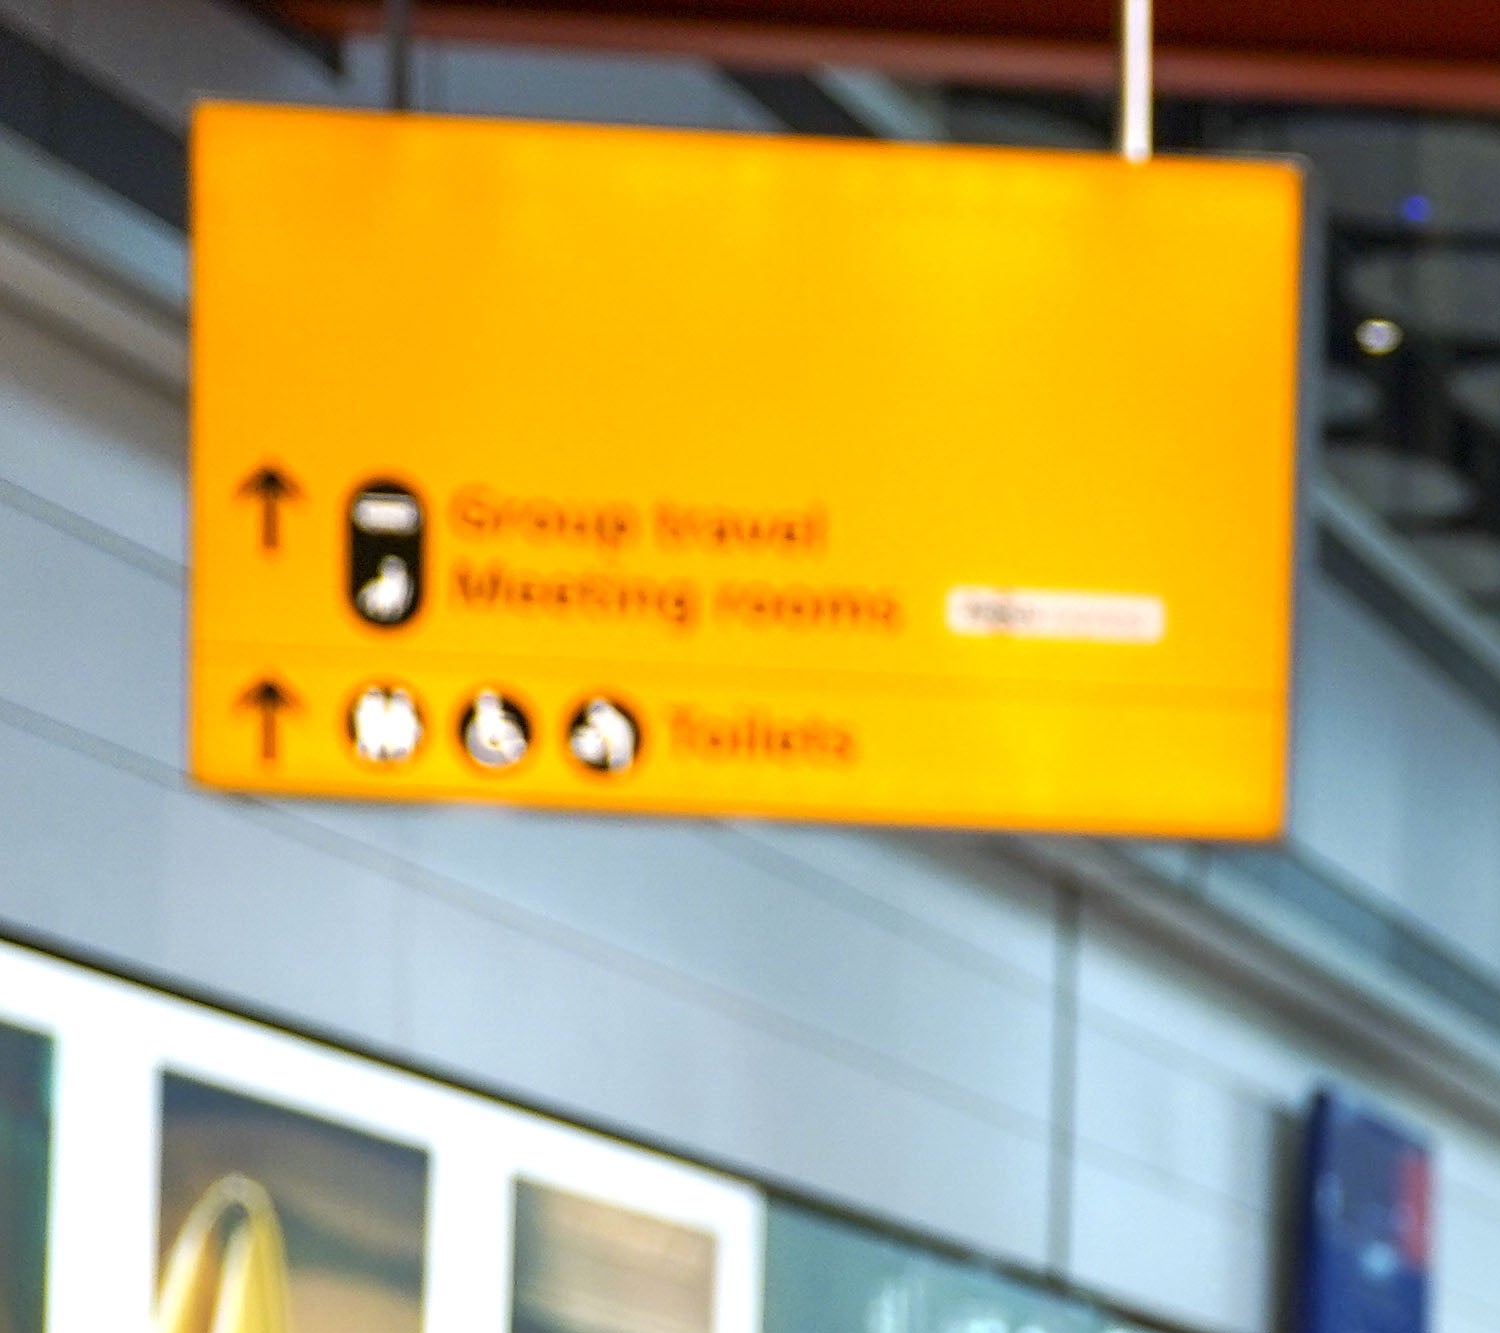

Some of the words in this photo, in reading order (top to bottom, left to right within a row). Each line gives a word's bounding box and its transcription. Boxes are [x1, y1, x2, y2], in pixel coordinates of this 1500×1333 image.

[450, 484, 638, 558] Group
[654, 497, 828, 554] travel
[450, 558, 697, 640] Meeting
[712, 580, 902, 634] rooms
[668, 703, 858, 766] Toilets
